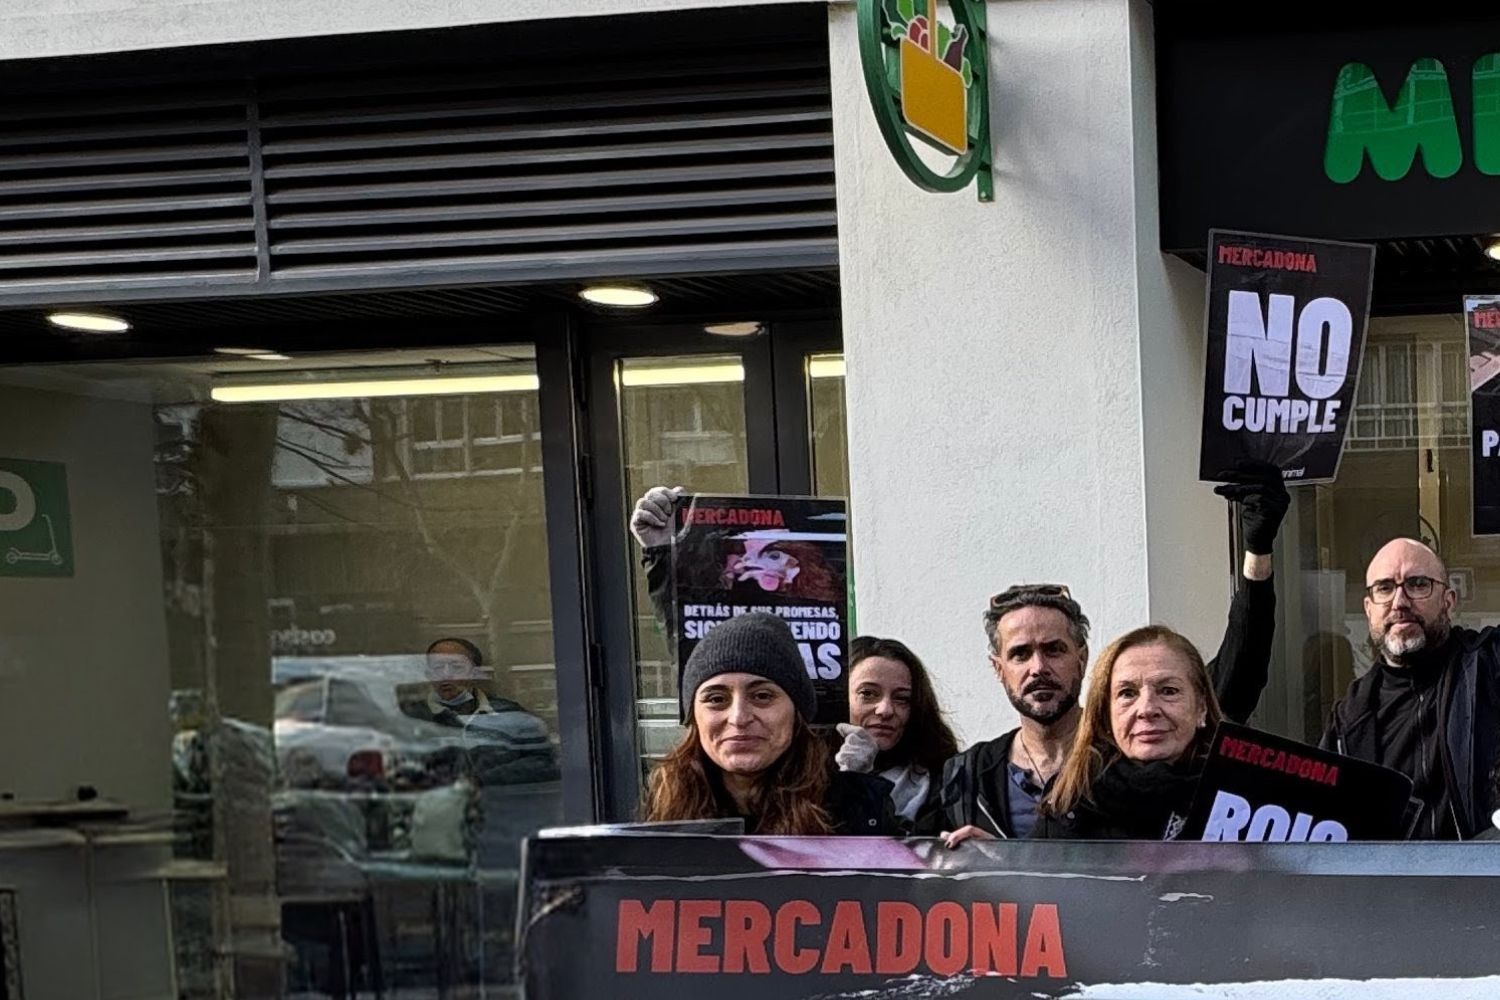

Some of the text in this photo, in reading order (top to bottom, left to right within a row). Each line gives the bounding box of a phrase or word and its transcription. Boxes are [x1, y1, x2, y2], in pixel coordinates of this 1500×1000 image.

[1218, 245, 1317, 273] MERCADONA
[1224, 290, 1353, 399] NO
[1222, 396, 1341, 433] CUMPLE
[682, 508, 785, 526] MERCADONA
[684, 602, 730, 617] DETRÁS
[775, 606, 839, 620] PROMESAS,
[1219, 736, 1342, 786] MERCADONA
[614, 900, 1067, 977] MERCADONA
